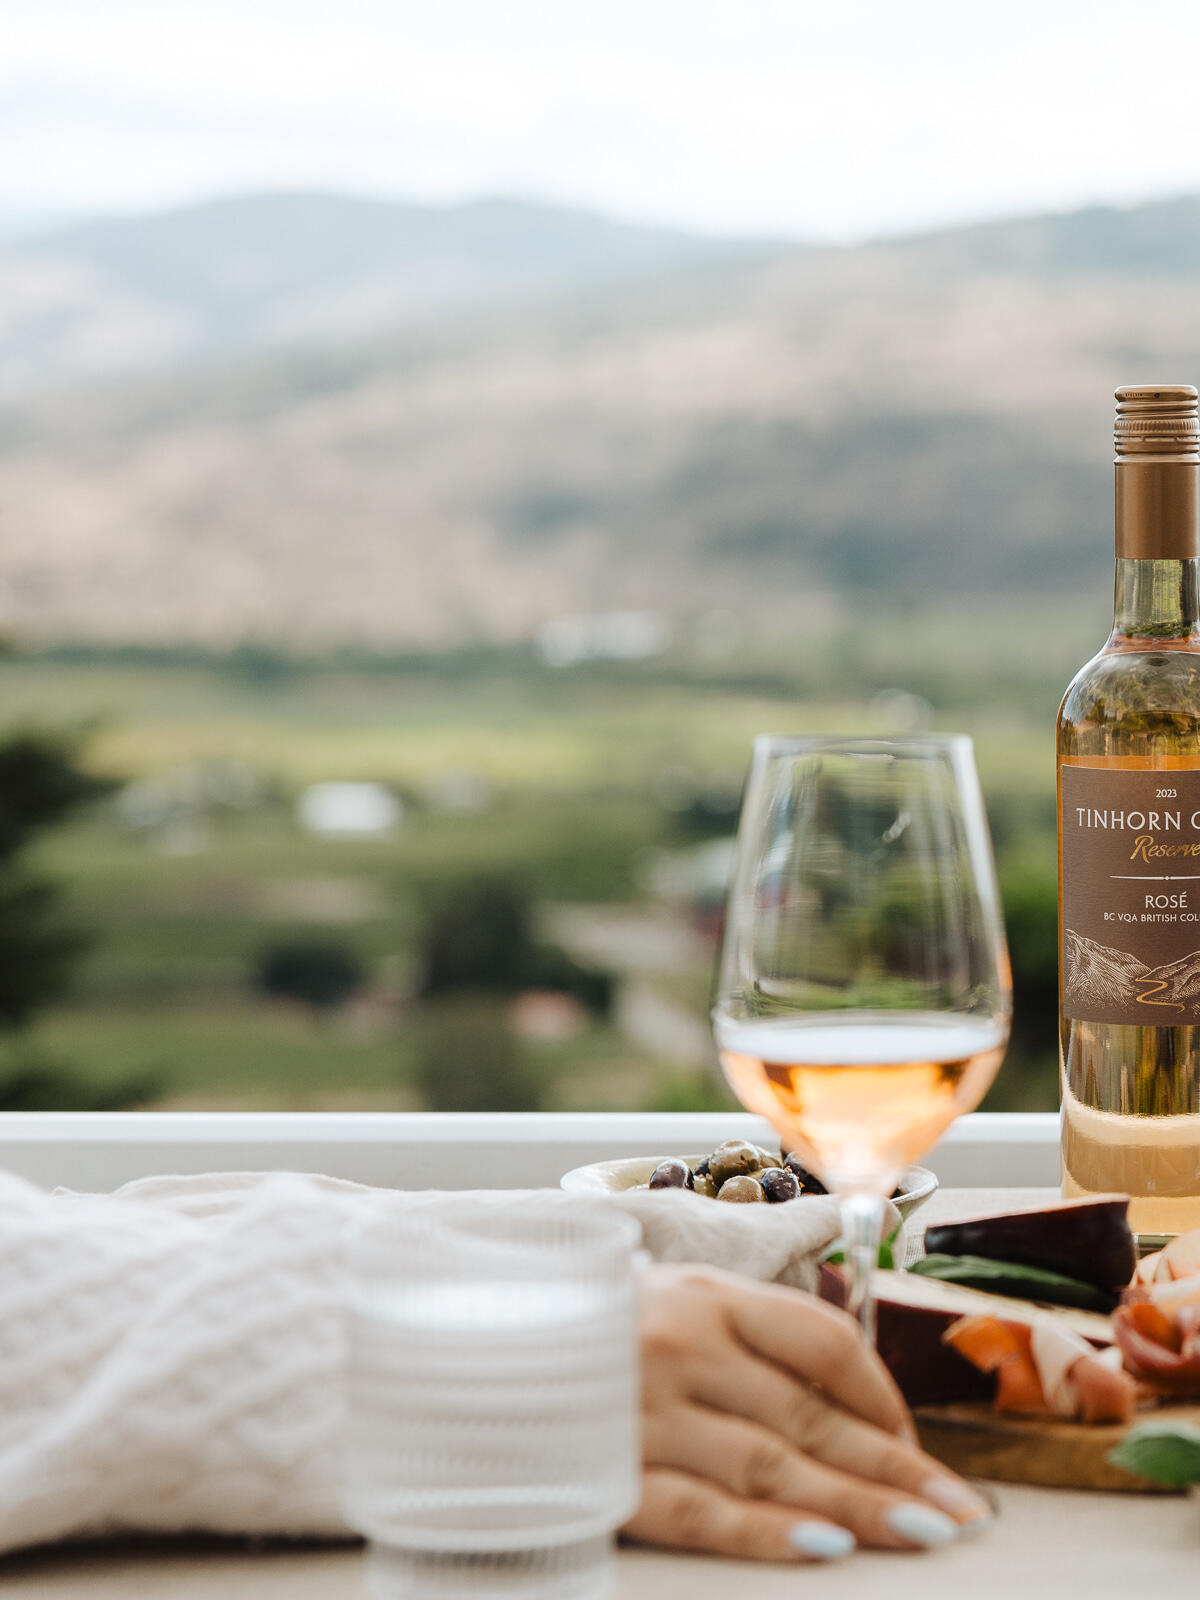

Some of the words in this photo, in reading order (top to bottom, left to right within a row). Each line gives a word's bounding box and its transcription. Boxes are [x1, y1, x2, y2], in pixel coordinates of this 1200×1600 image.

[1156, 789, 1177, 798] 2023
[1076, 807, 1181, 830] TINHORN
[1145, 891, 1187, 909] ROSÉ
[1104, 912, 1115, 921] BC
[1118, 913, 1138, 923] VQA
[1141, 913, 1176, 922] BRITISH
